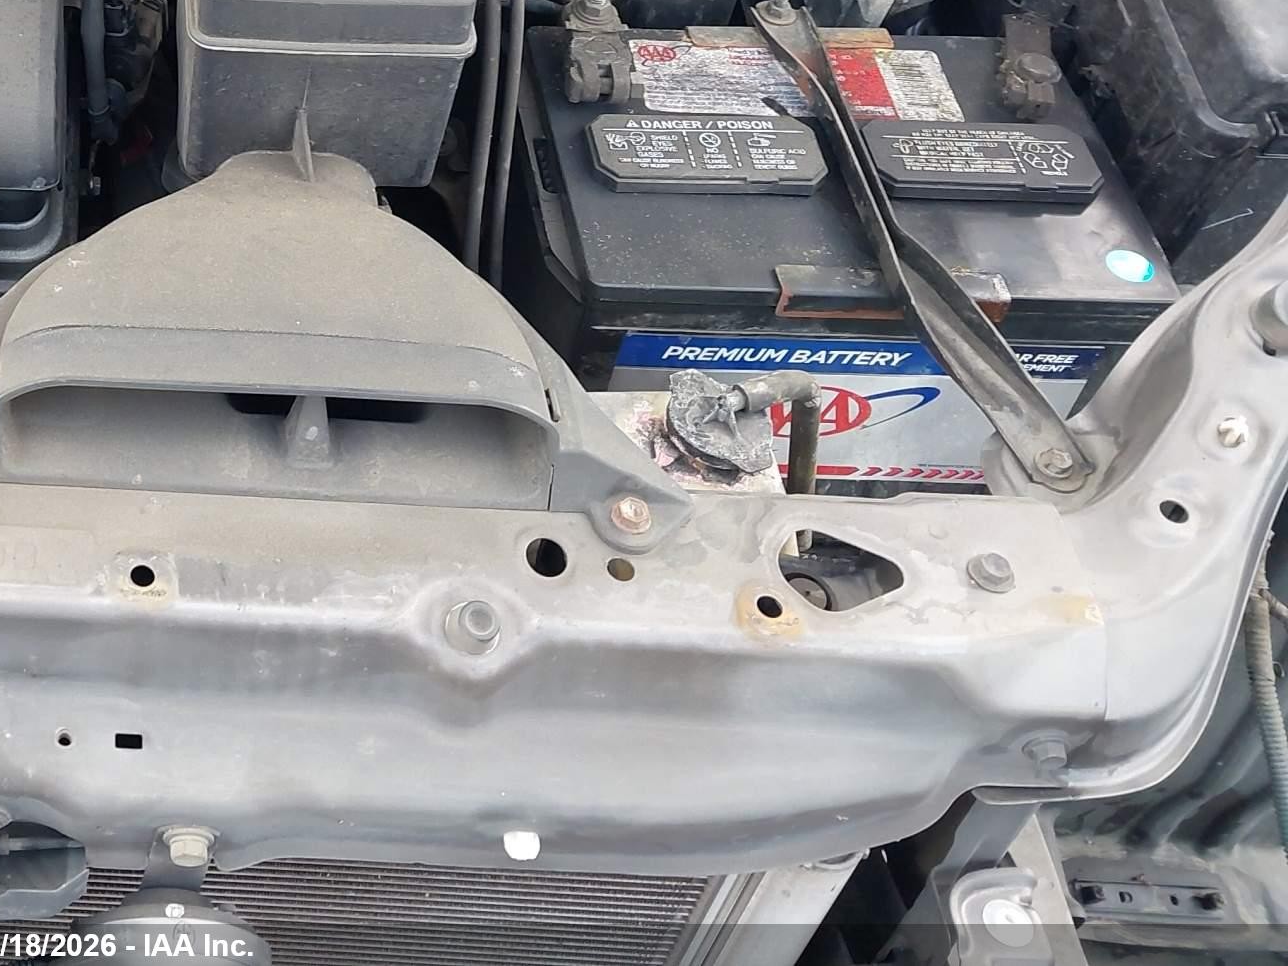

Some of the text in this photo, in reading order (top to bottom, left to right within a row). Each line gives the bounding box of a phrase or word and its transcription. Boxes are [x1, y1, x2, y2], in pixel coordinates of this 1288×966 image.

[639, 45, 675, 61] AAA
[641, 120, 773, 130] DANGER / POISON
[661, 344, 913, 367] PREMIUM BATTERY
[1033, 354, 1080, 364] FREE
